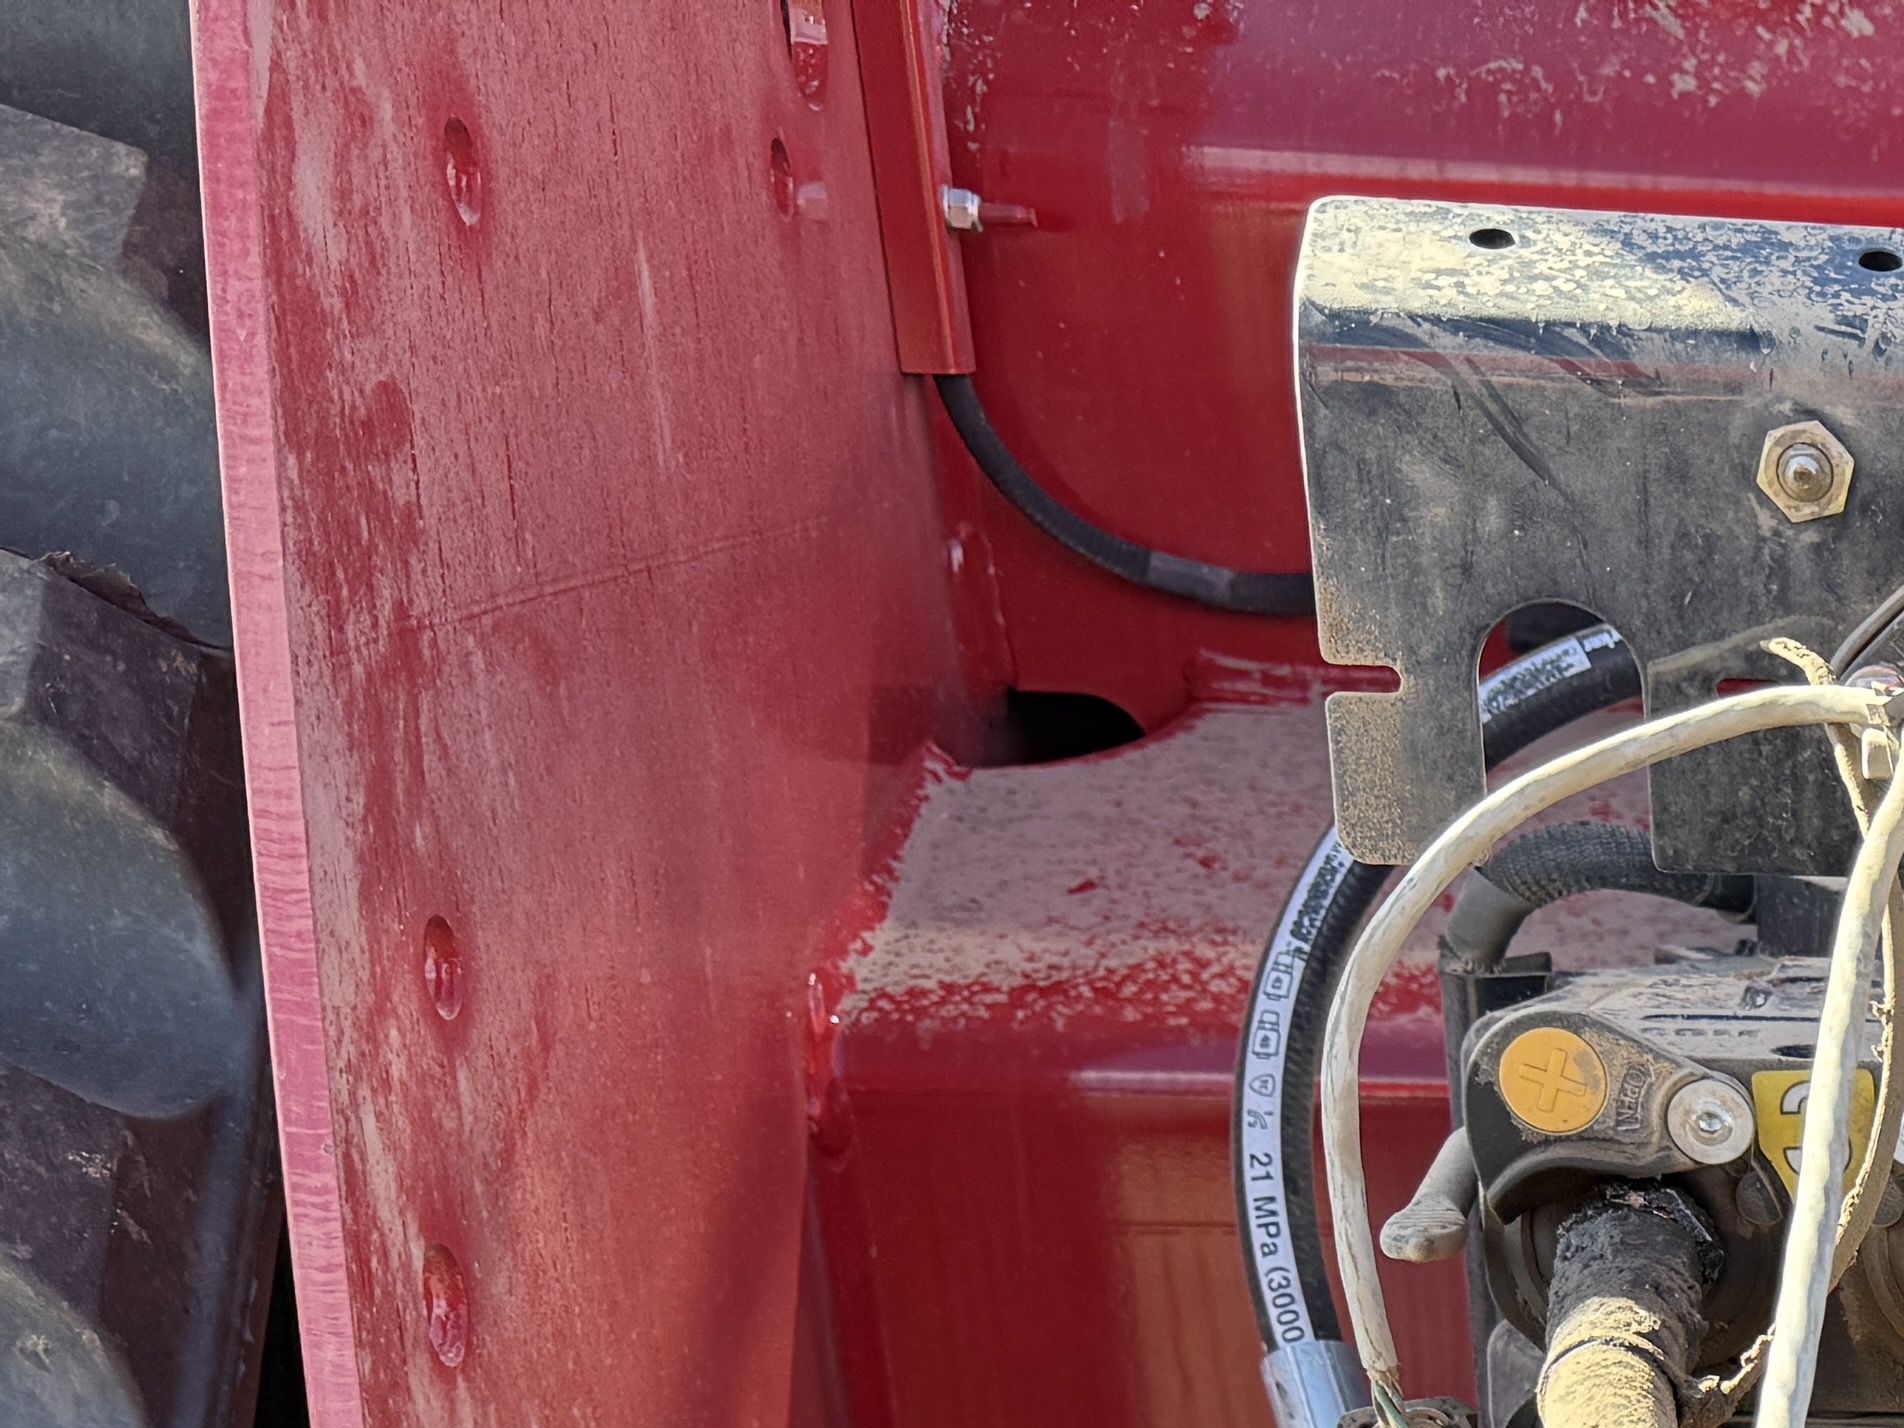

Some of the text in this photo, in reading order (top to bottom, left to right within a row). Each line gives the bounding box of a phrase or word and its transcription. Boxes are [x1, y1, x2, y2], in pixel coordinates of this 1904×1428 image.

[1249, 1152, 1273, 1182] 21
[1253, 1196, 1281, 1258] MPa
[1265, 1267, 1305, 1344] (3000
